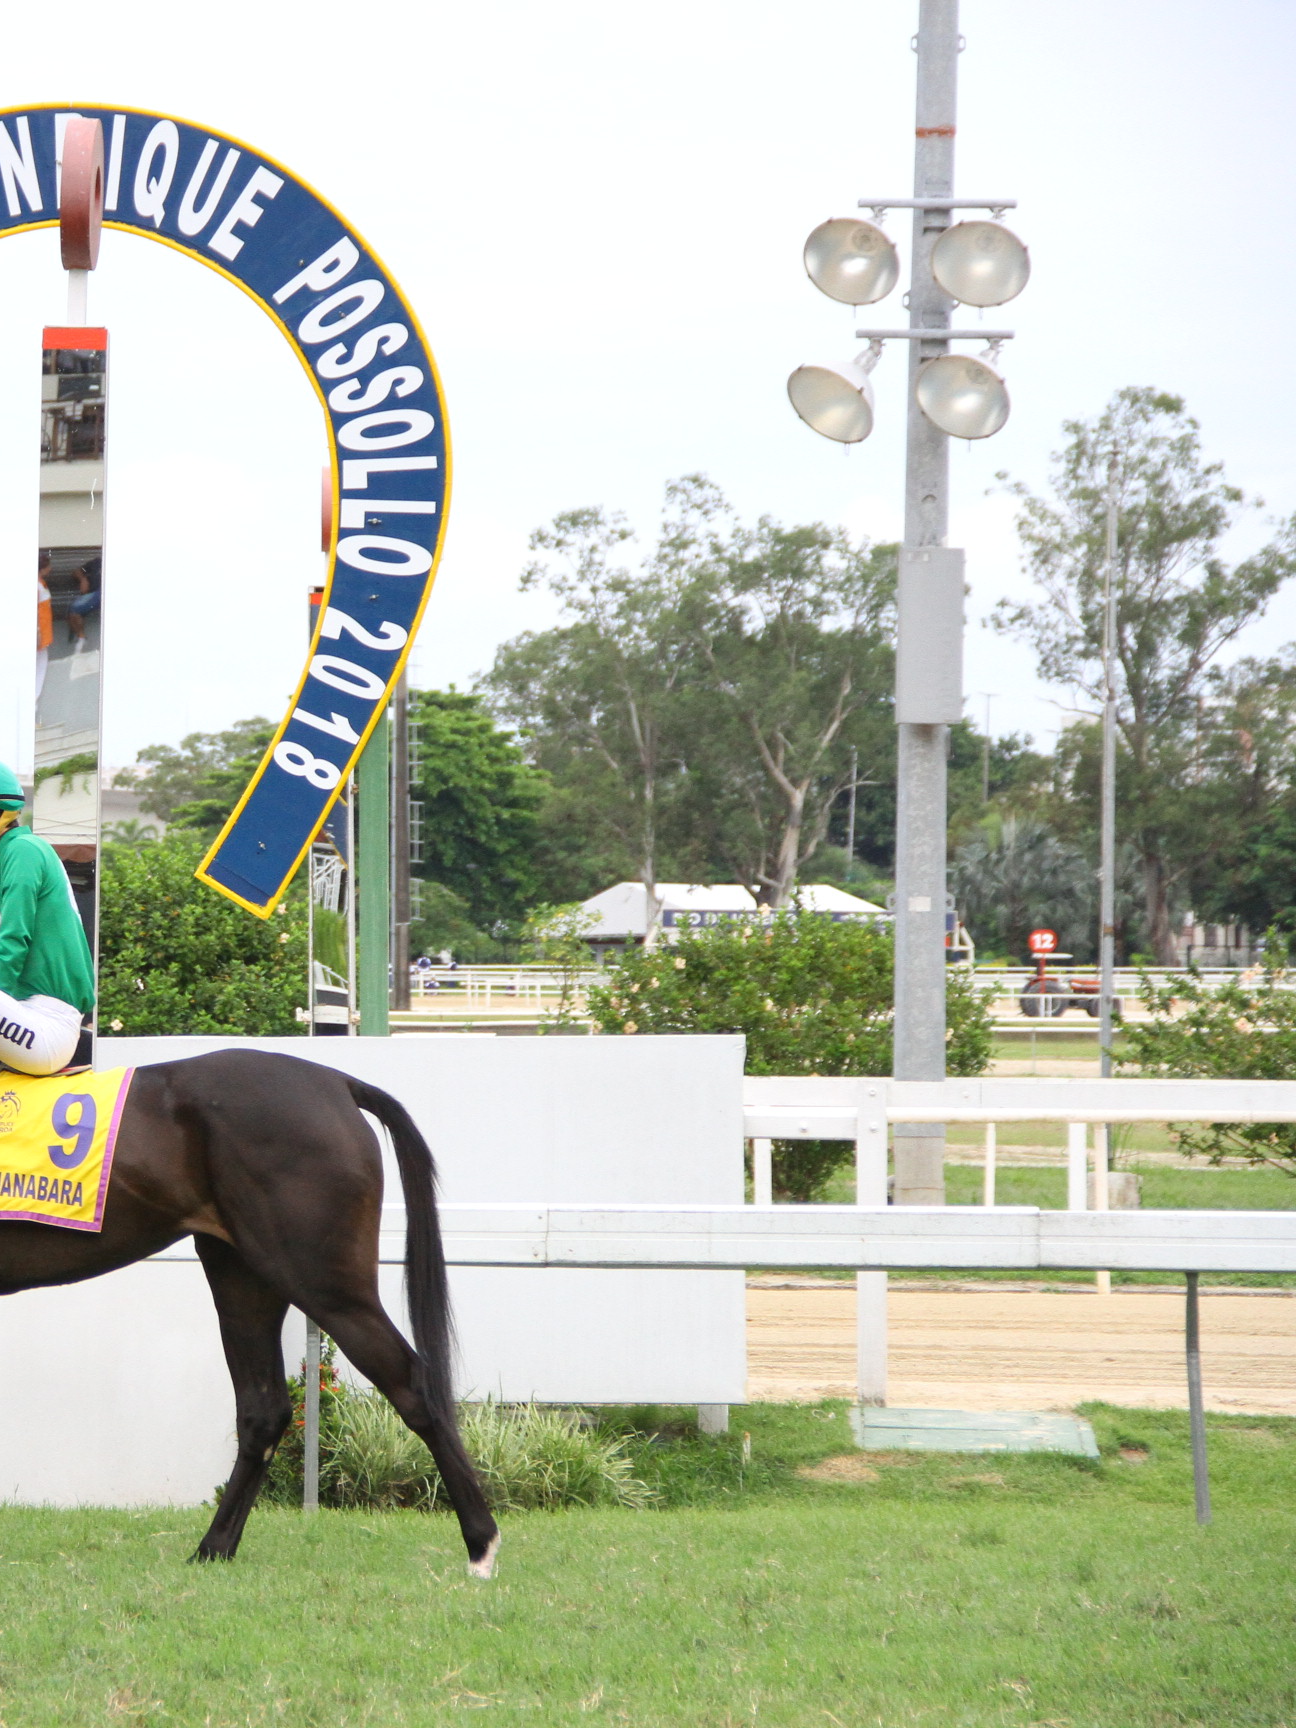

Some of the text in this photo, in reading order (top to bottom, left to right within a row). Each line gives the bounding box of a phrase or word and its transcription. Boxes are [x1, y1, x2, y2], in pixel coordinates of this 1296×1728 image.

[272, 235, 439, 577] POSSOLLO
[273, 605, 408, 790] 2018
[1031, 932, 1055, 950] 12
[47, 1092, 97, 1170] 9
